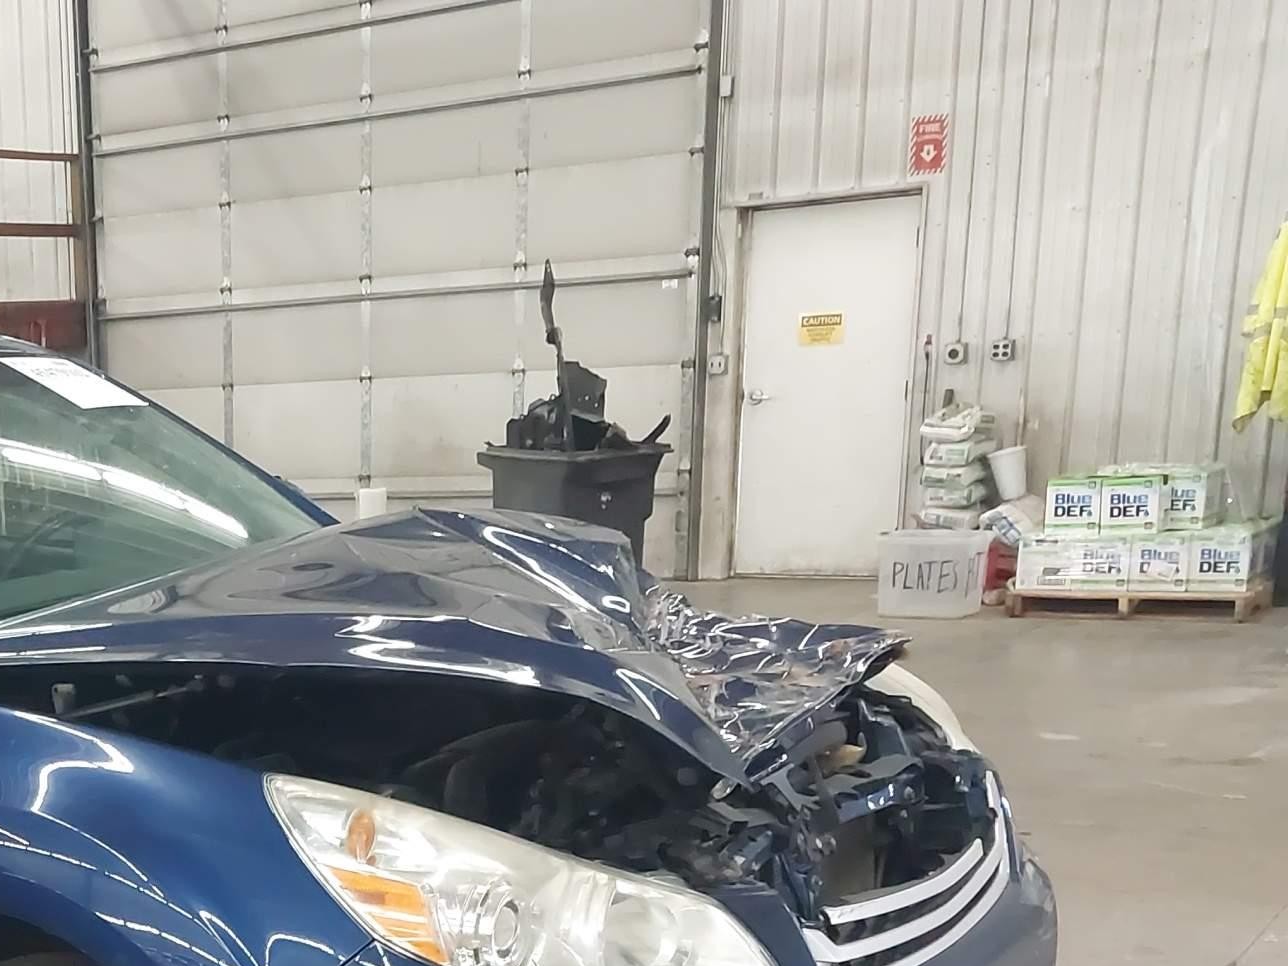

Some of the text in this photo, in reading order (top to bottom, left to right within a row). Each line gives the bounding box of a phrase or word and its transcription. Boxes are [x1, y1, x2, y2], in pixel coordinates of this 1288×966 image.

[802, 316, 841, 326] CAUTION
[1171, 486, 1196, 498] lue
[1055, 493, 1092, 504] Blue
[1110, 493, 1149, 504] Blue
[1054, 505, 1091, 517] DEF
[1170, 499, 1195, 511] EF
[1109, 505, 1148, 518] DEF
[1140, 549, 1180, 560] Blue
[1200, 548, 1240, 560] Blue
[1199, 561, 1239, 573] DEF
[892, 560, 960, 593] PLATES
